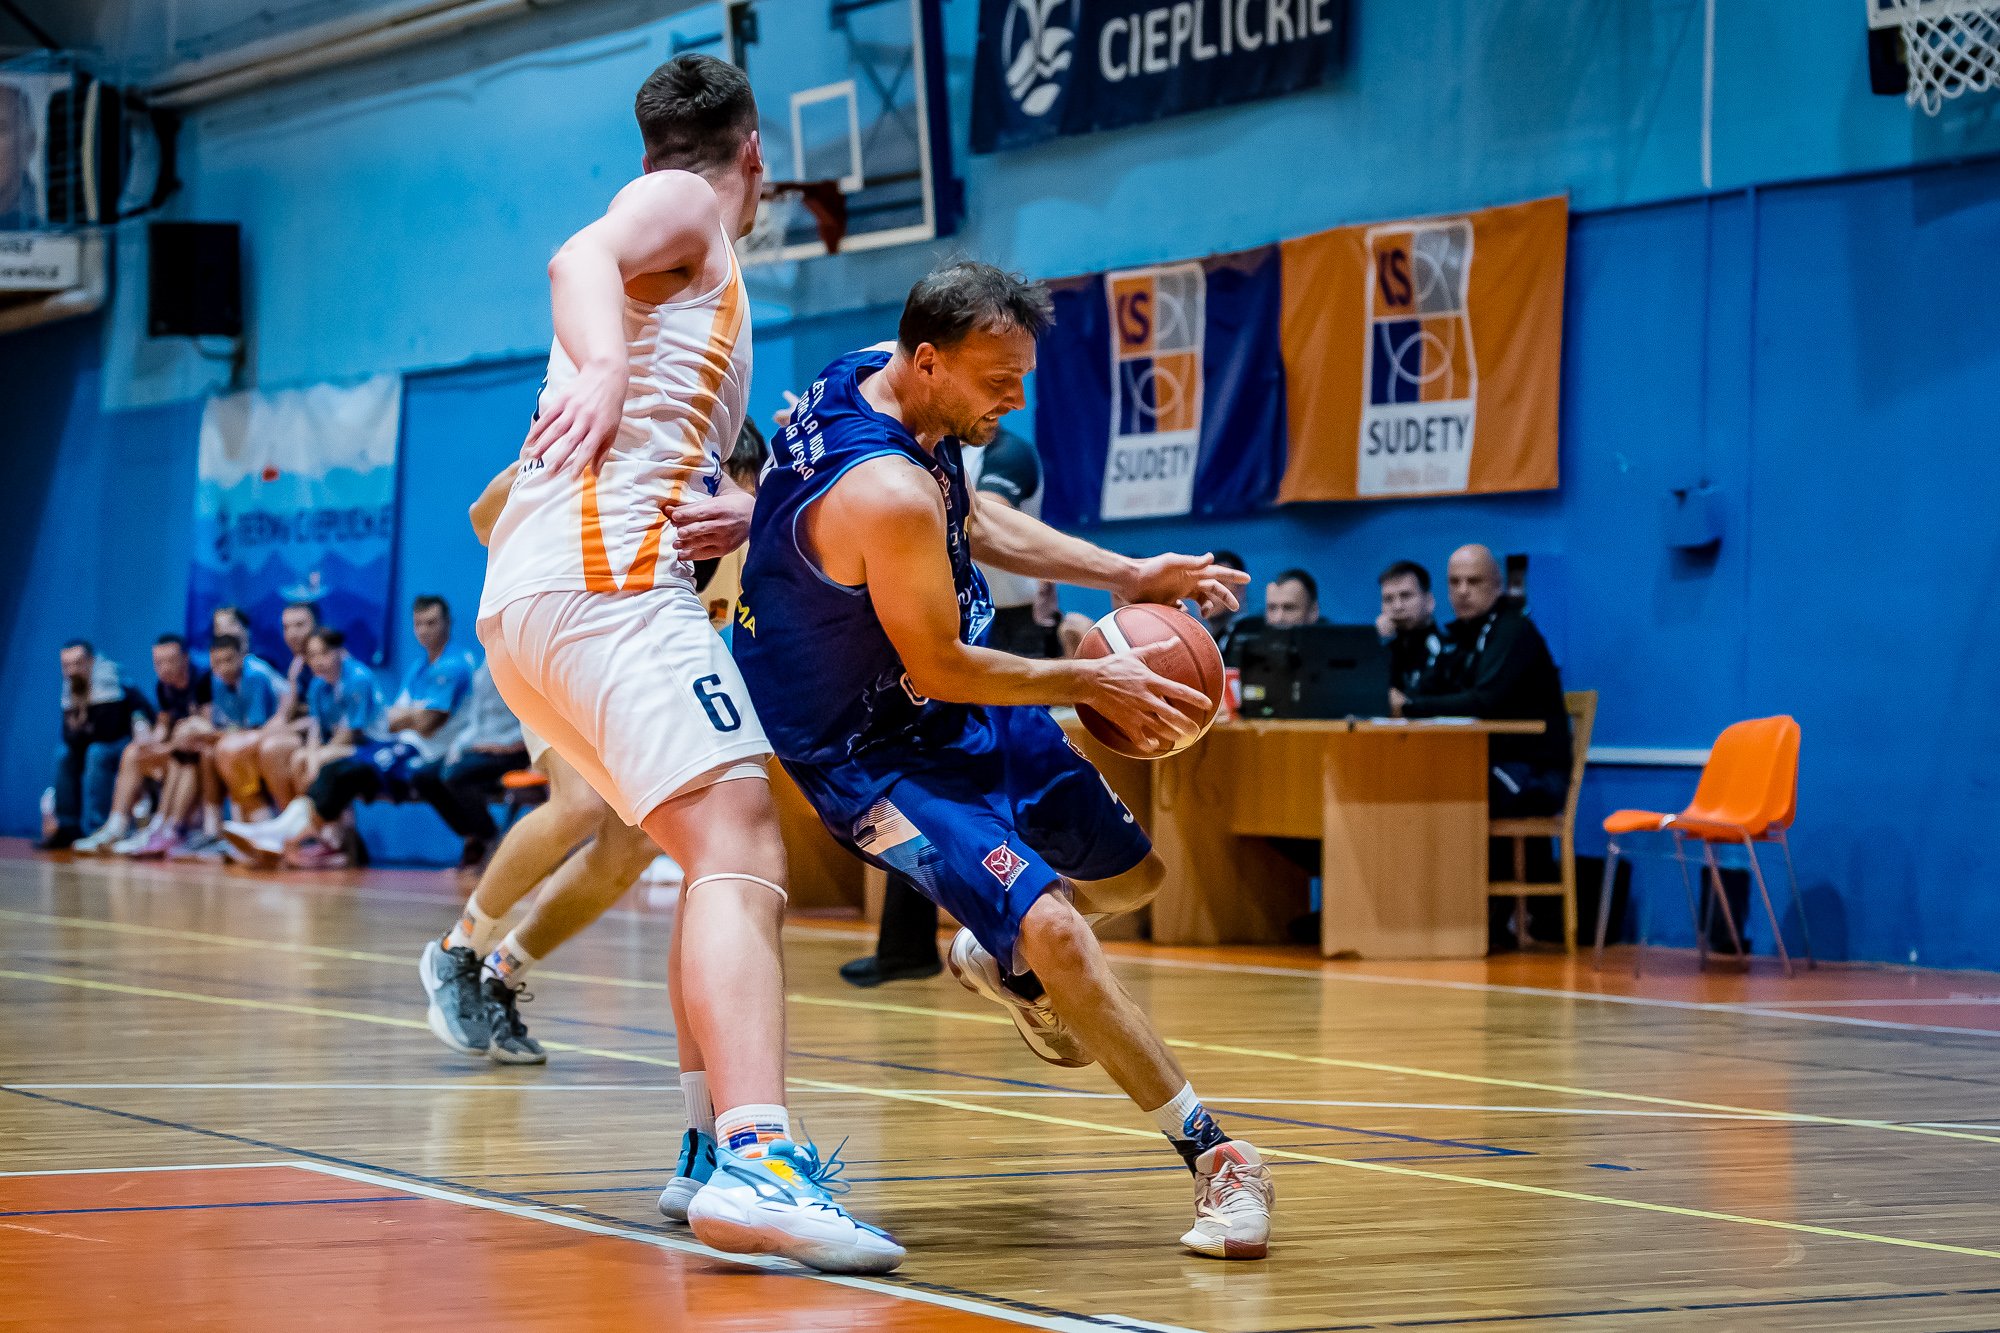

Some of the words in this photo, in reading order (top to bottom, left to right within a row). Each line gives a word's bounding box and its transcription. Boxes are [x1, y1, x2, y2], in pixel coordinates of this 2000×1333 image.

[1100, 0, 1333, 82] CIEPLICKIE
[1366, 414, 1471, 457] SUDETY
[1111, 444, 1191, 483] SUDETY
[692, 673, 742, 732] 6
